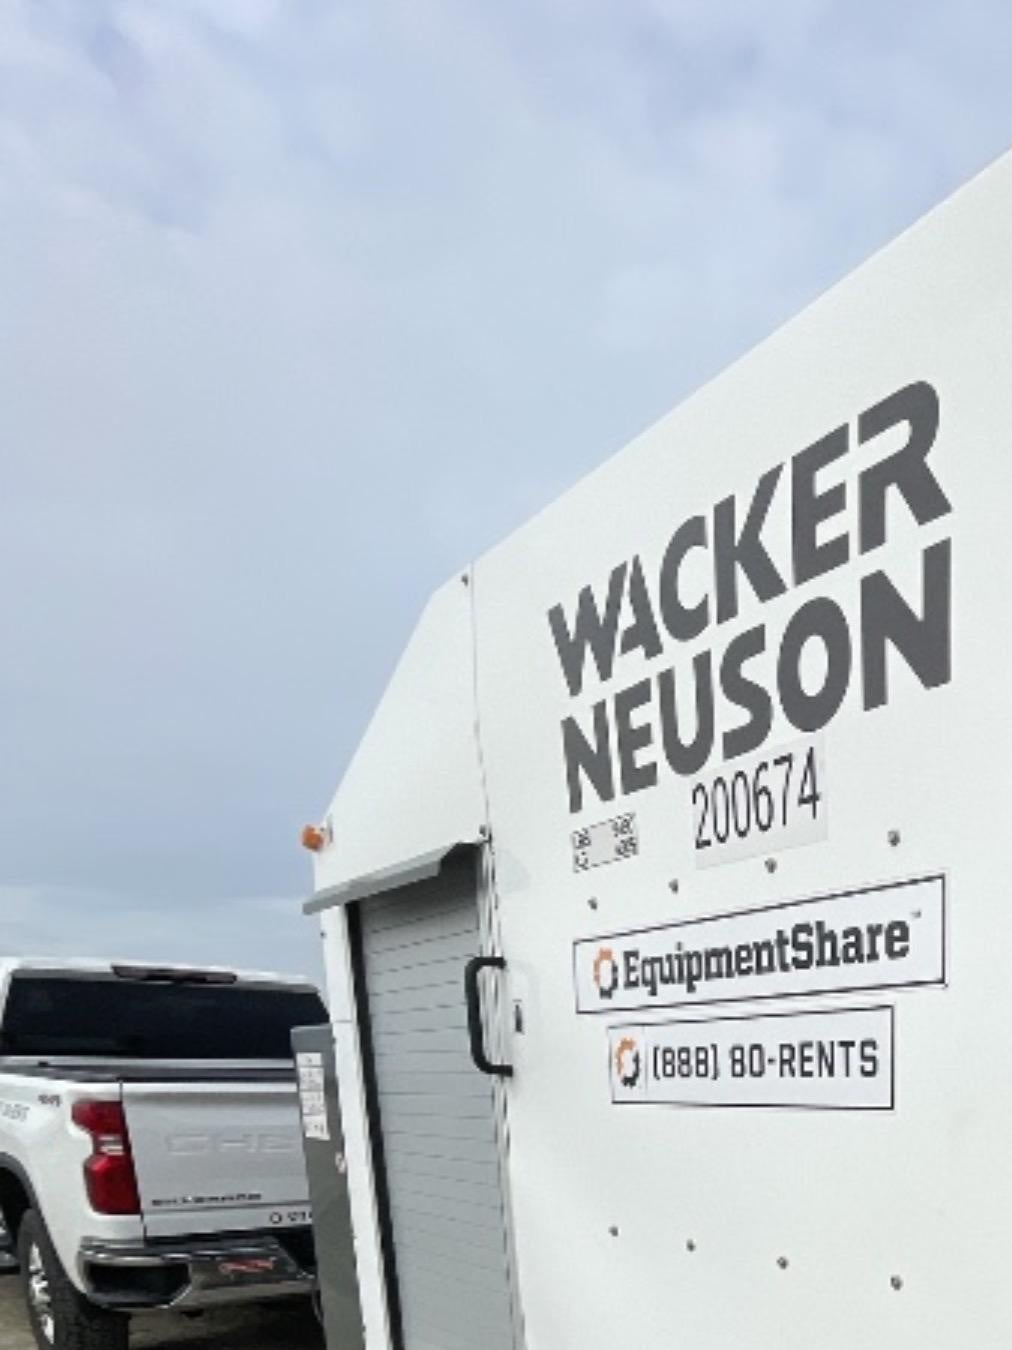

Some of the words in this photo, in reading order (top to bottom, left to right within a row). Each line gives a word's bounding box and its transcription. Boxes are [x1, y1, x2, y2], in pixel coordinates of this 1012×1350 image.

[547, 380, 952, 697] WACKER
[561, 536, 951, 814] NEUSON
[692, 746, 820, 849] 200674
[622, 919, 910, 993] EquipmentShare
[729, 1038, 879, 1079] 80-RENTS
